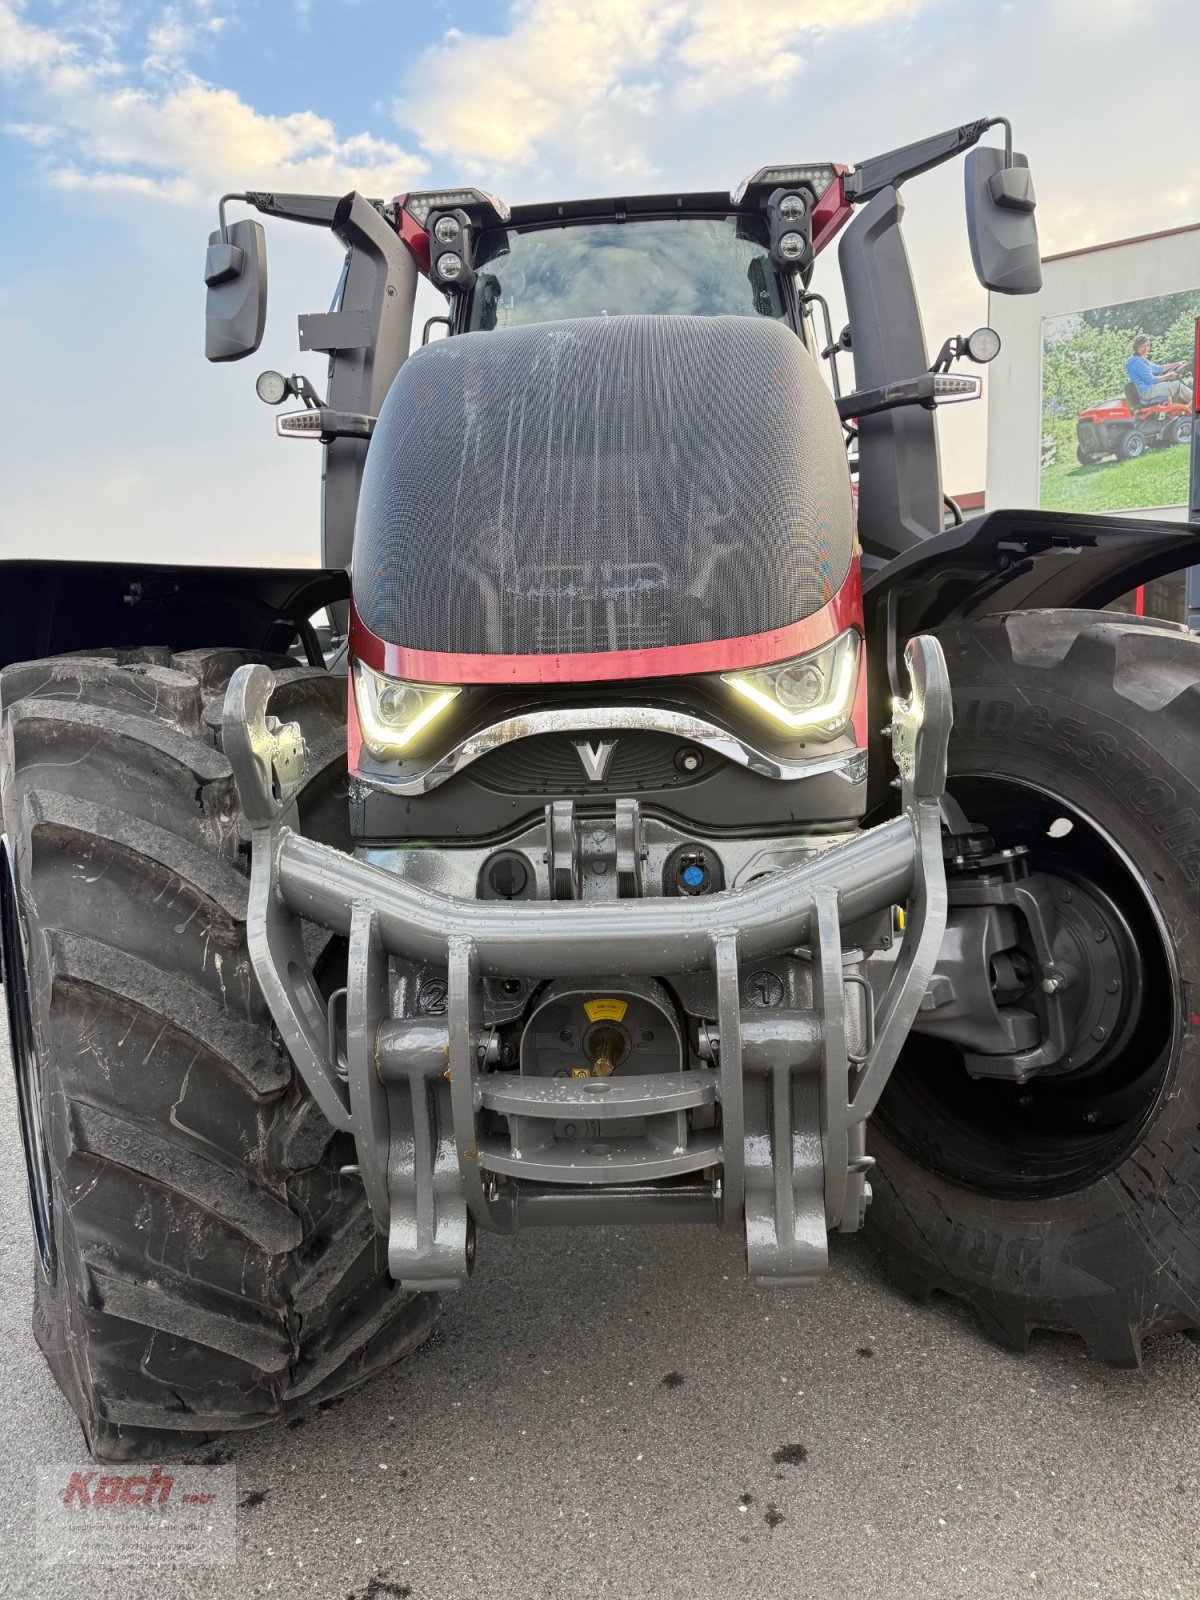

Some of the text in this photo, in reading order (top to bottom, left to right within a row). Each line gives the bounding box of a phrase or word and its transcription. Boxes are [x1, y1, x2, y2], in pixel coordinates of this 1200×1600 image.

[571, 739, 618, 780] V
[424, 983, 447, 1015] 2
[754, 976, 770, 1005] 1
